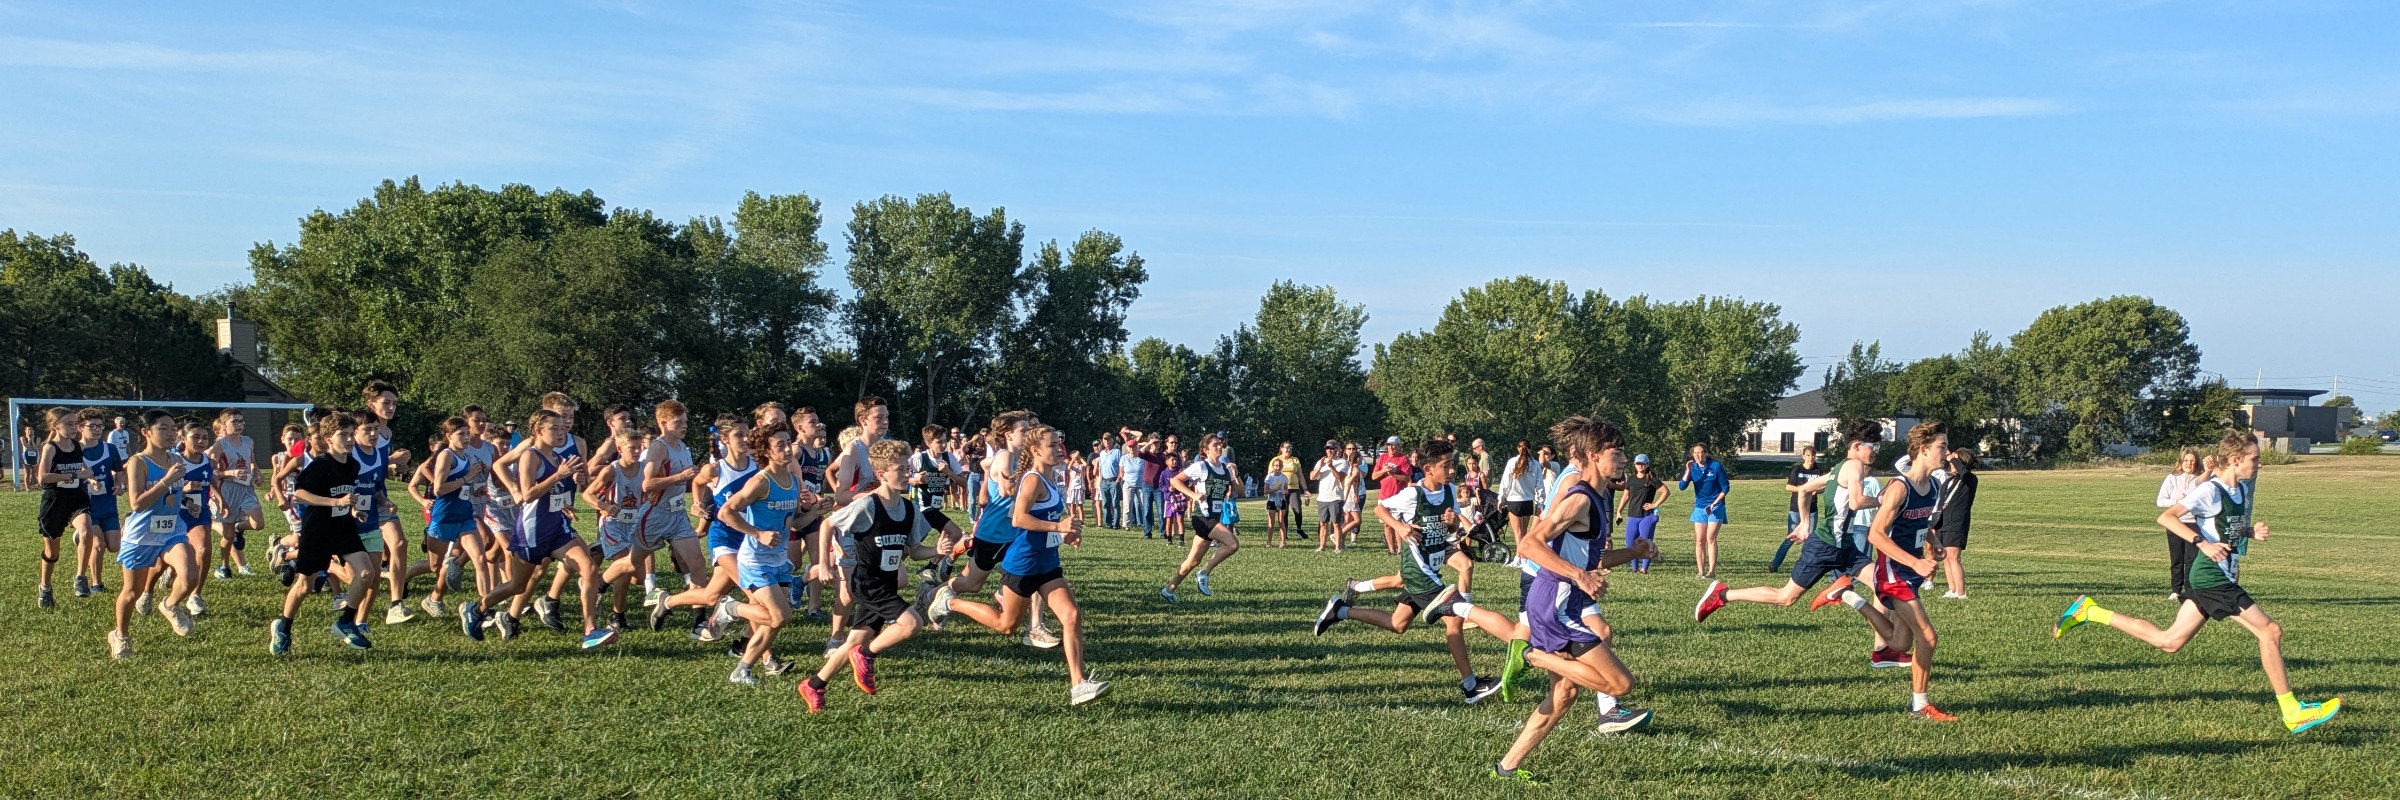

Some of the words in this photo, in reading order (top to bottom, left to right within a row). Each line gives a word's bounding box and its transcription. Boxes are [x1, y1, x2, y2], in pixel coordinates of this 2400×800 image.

[502, 498, 512, 506] 87
[623, 512, 633, 520] 79
[1422, 514, 1439, 523] WEST
[155, 519, 174, 529] 135
[888, 555, 899, 566] 63
